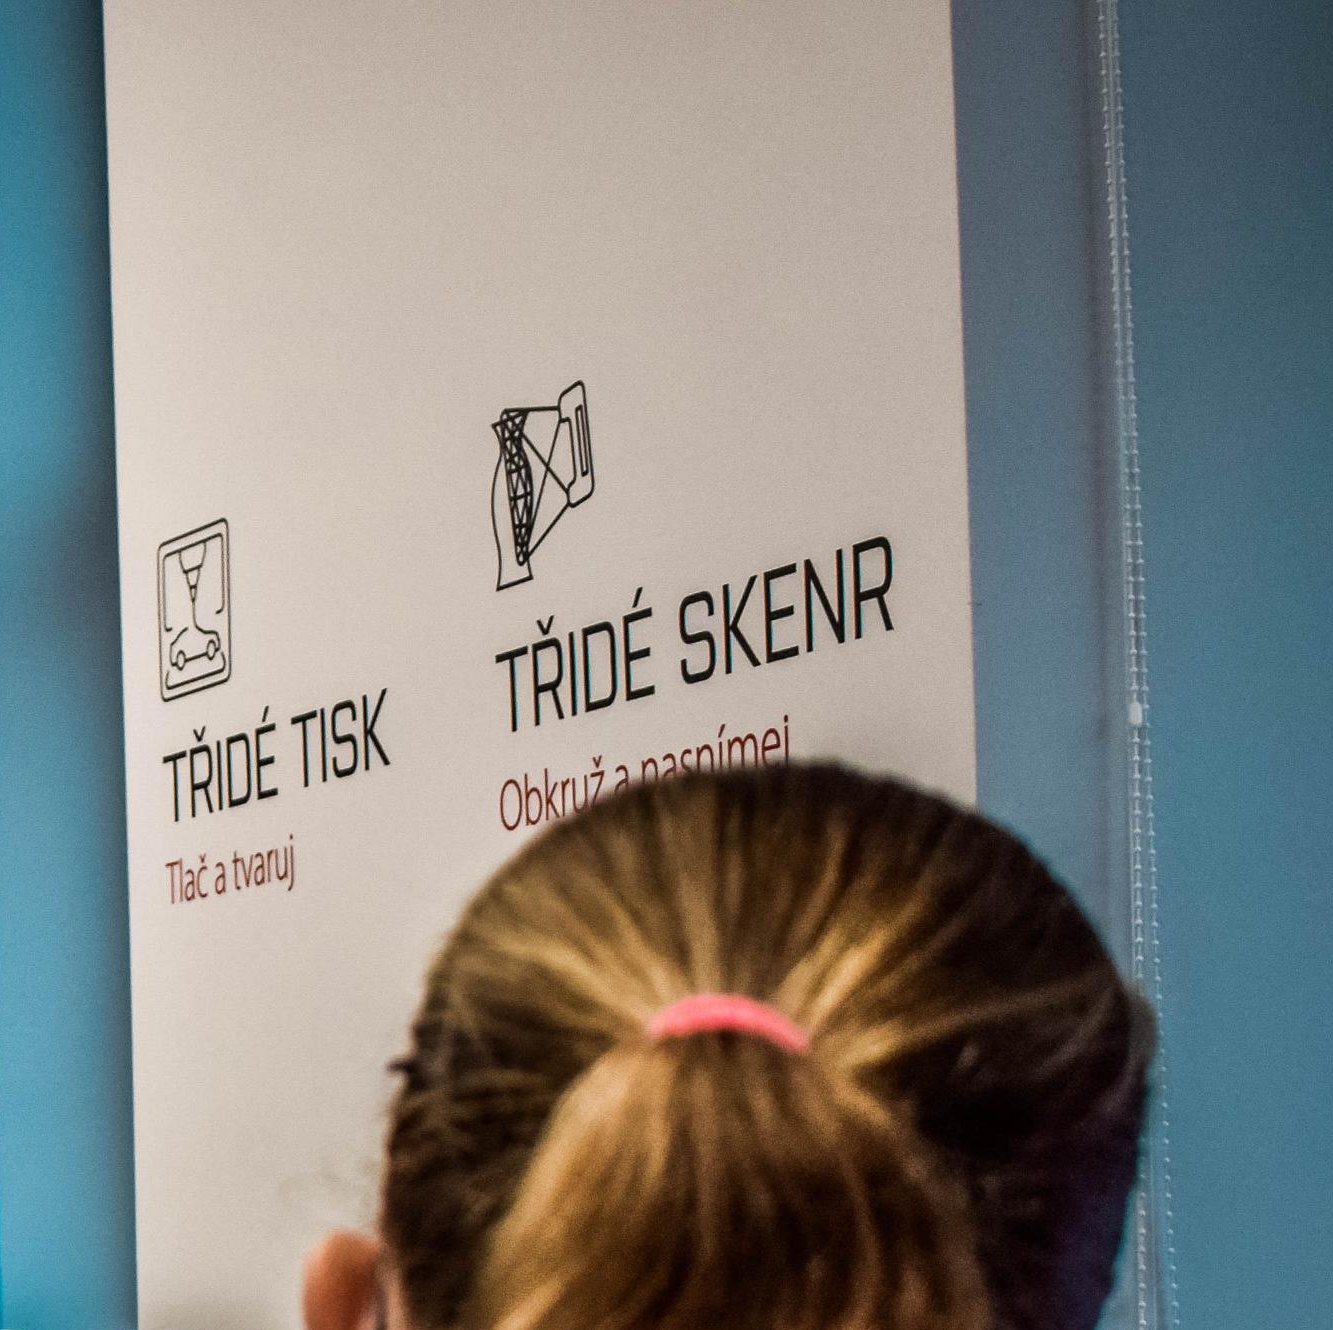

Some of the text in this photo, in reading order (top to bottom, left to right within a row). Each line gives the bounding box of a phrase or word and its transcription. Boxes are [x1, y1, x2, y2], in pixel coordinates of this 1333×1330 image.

[494, 535, 896, 733] TŘIDÉ SKENR
[162, 688, 391, 822] TŘIDÉ TISK
[499, 755, 606, 831] Obkruž
[614, 764, 629, 796] a
[165, 833, 295, 904] Tlač a tvaruj
